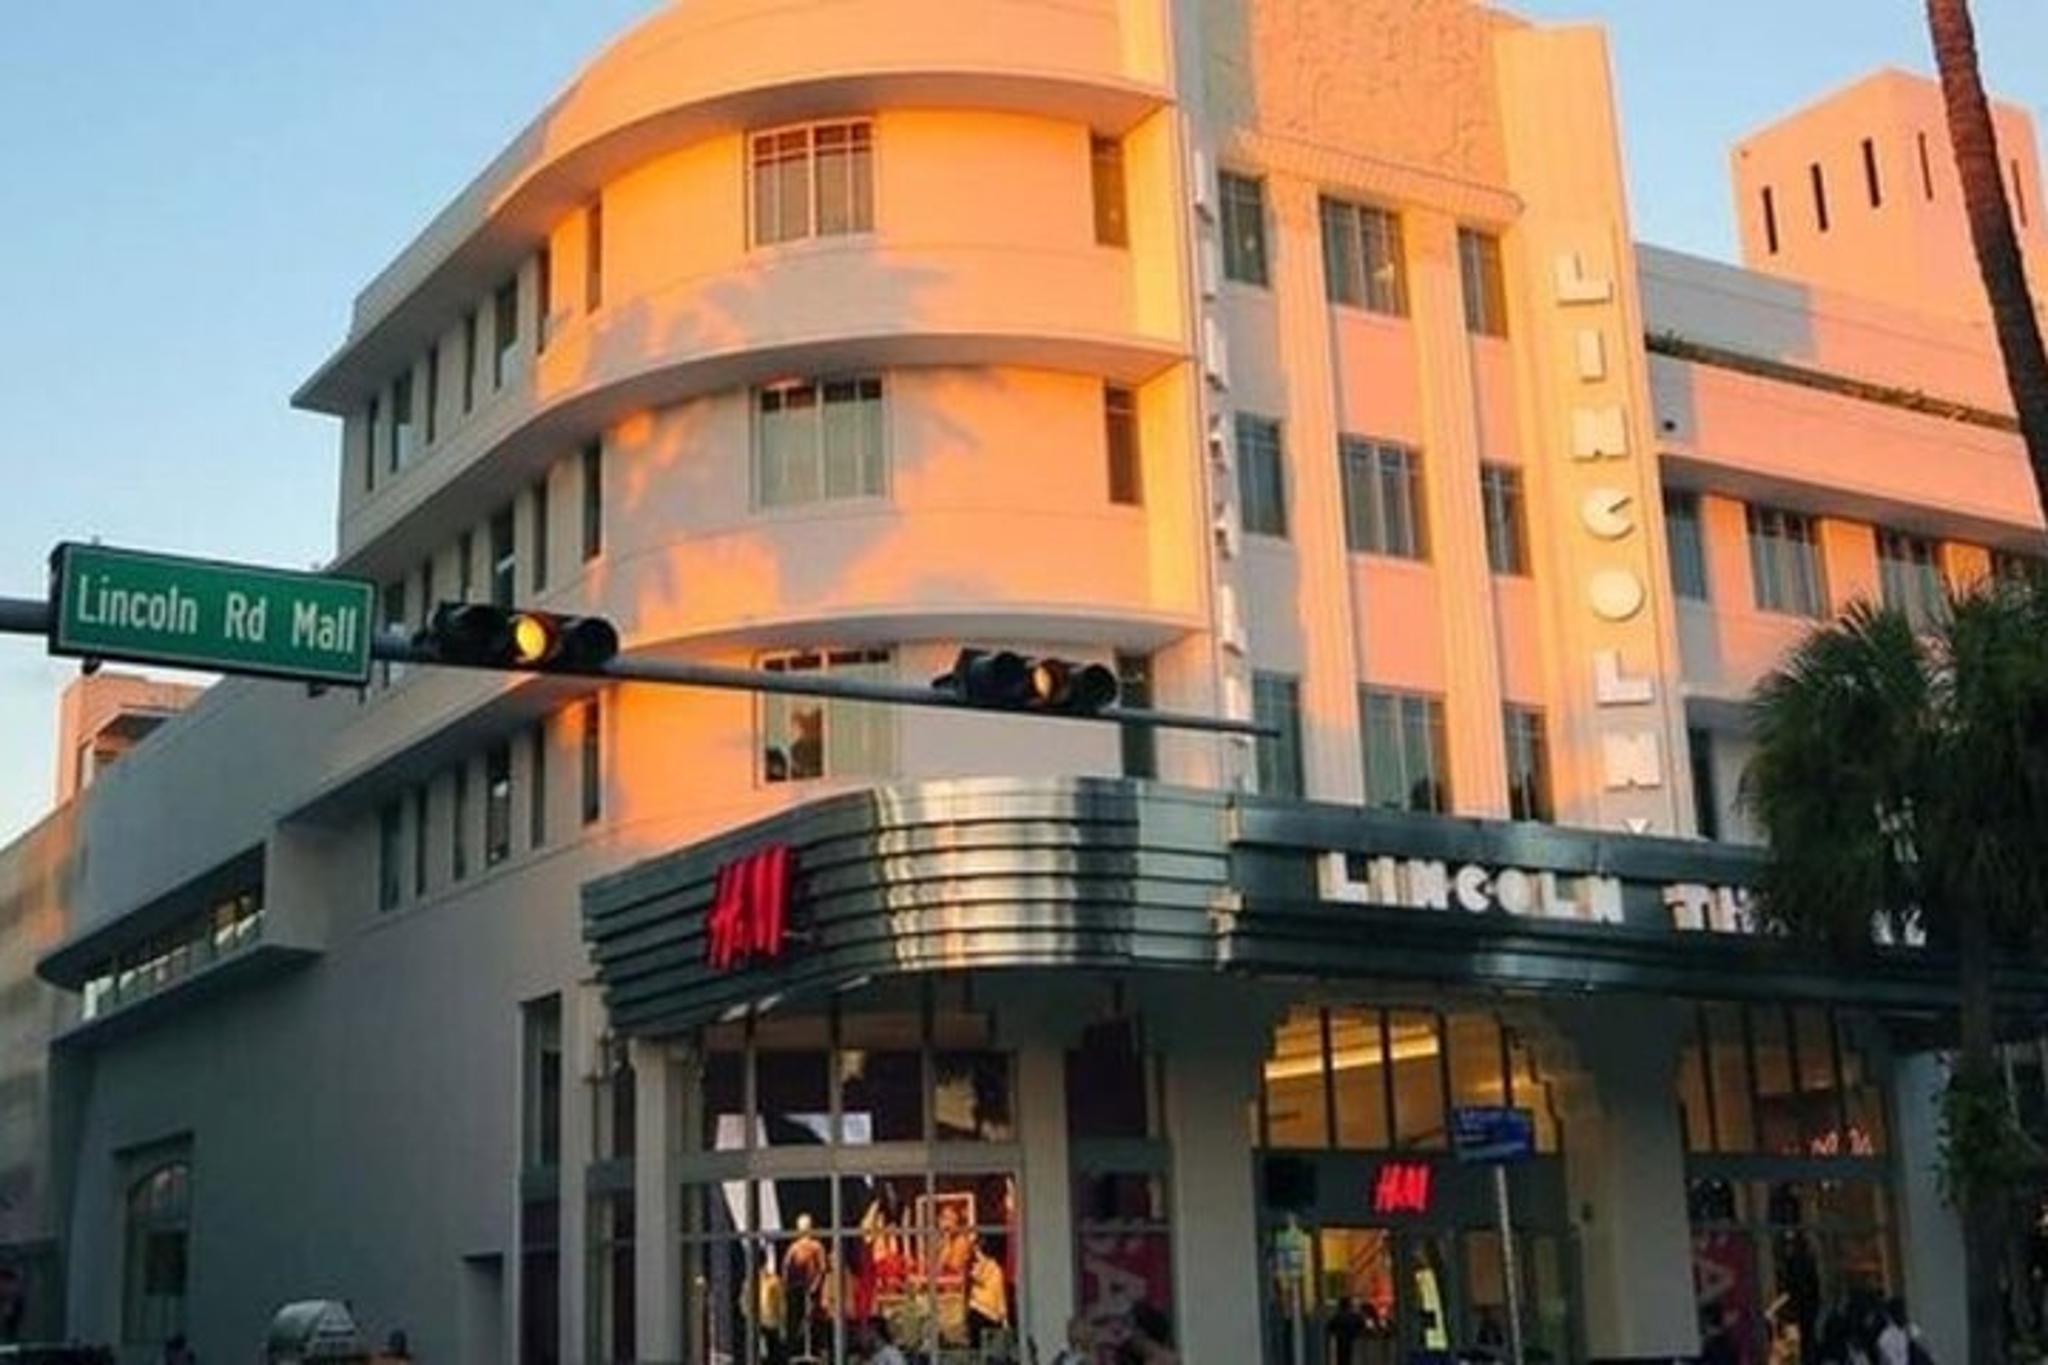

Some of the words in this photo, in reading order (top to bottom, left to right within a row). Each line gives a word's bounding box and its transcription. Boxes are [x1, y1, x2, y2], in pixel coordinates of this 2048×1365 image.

[77, 575, 198, 634] Lincoln
[224, 591, 266, 642] Rd
[292, 601, 357, 654] Mall
[706, 844, 789, 970] H&M
[1316, 851, 1625, 924] LINCOLN
[1373, 1161, 1432, 1214] H&M
